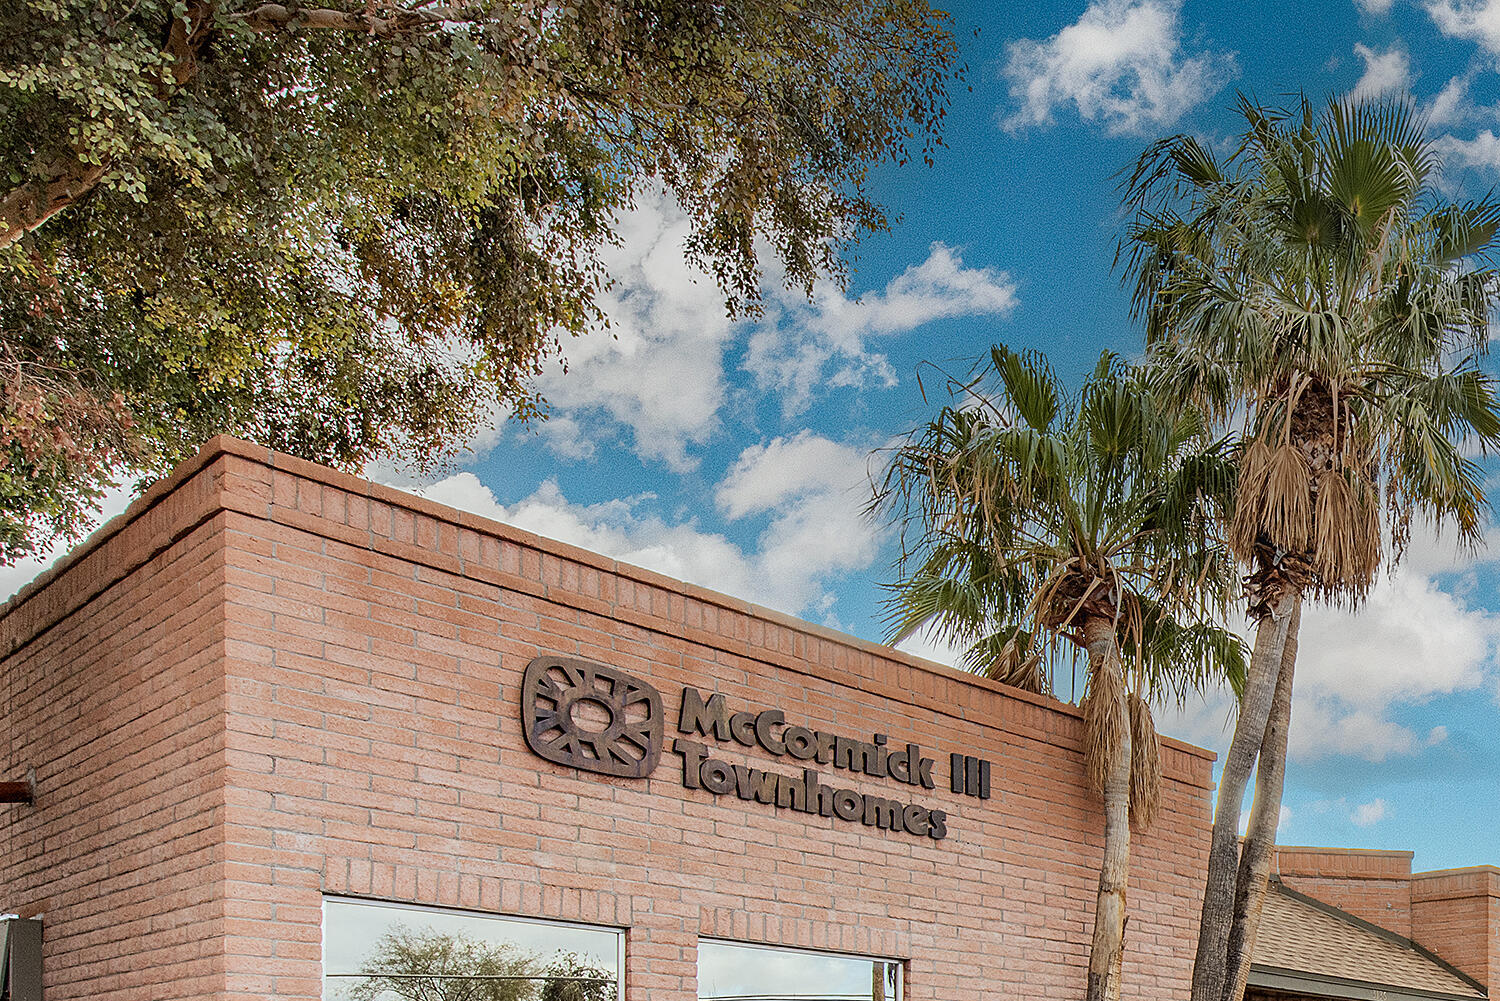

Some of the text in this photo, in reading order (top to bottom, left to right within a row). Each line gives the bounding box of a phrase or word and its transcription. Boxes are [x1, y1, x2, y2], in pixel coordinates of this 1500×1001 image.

[672, 738, 948, 840] Townhomes
[677, 686, 992, 800] McCormick III
